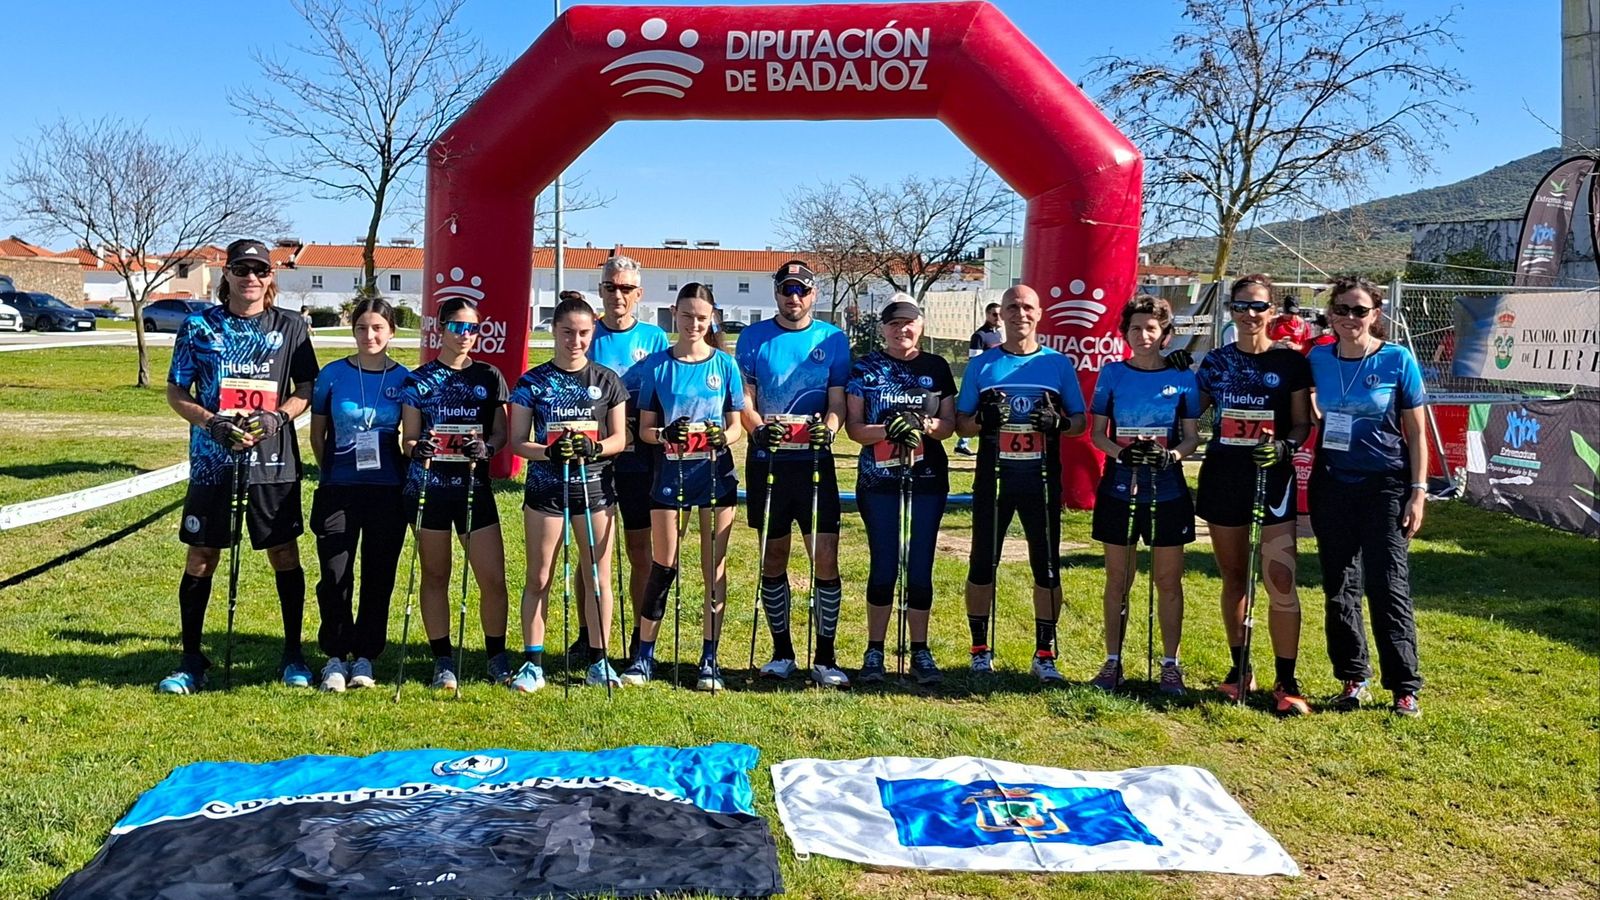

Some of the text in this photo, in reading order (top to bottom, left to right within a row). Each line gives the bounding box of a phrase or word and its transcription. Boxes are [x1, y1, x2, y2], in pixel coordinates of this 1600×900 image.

[726, 20, 930, 60] DIPUTACIÓN
[725, 59, 928, 92] DE BADAJOZ
[422, 315, 507, 338] DIPÓN
[1037, 331, 1124, 354] PUTACIÓN
[221, 359, 270, 375] Huelva
[234, 389, 264, 410] 30
[880, 392, 923, 405] Huelva
[1223, 392, 1265, 405] Huelva
[438, 405, 477, 417] Huelva
[551, 405, 592, 417] Huelva
[1234, 419, 1261, 439] 37
[1010, 432, 1035, 453] 63
